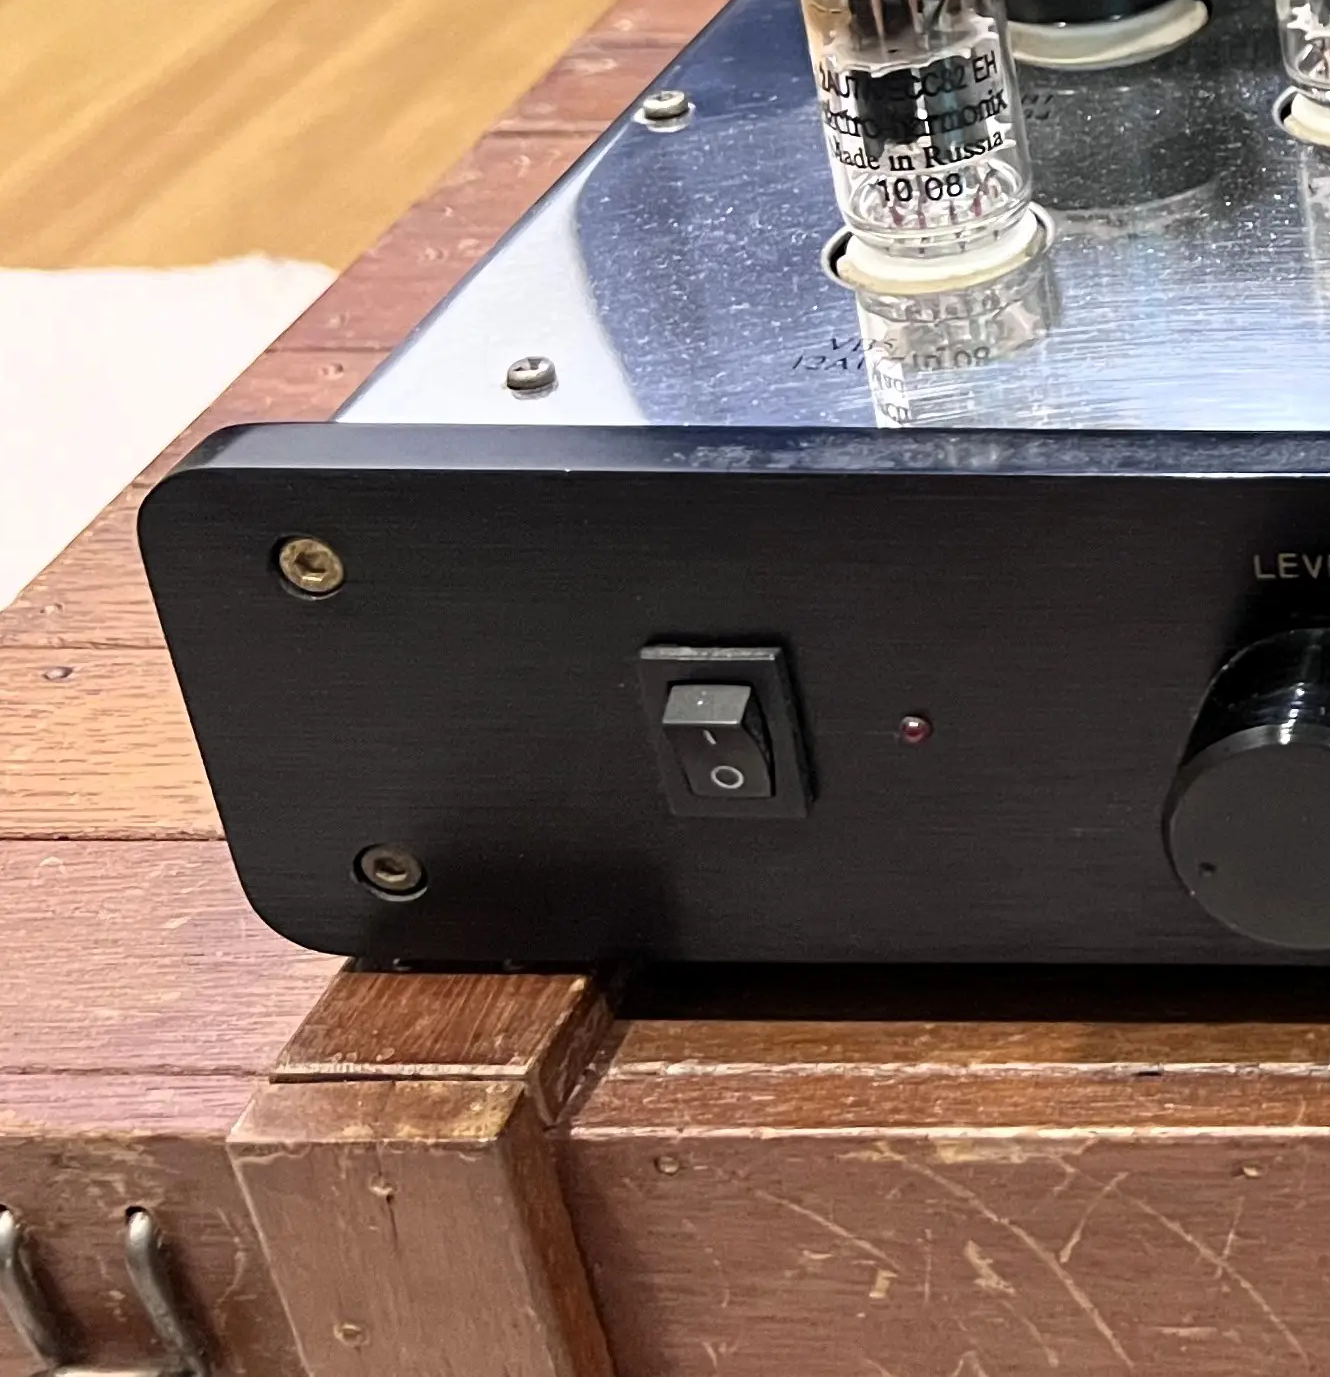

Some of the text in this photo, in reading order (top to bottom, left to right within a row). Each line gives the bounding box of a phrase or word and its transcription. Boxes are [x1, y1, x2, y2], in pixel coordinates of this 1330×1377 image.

[972, 50, 998, 83] EH
[889, 154, 915, 172] in
[924, 131, 1004, 169] Russia
[876, 172, 964, 204] 10 08
